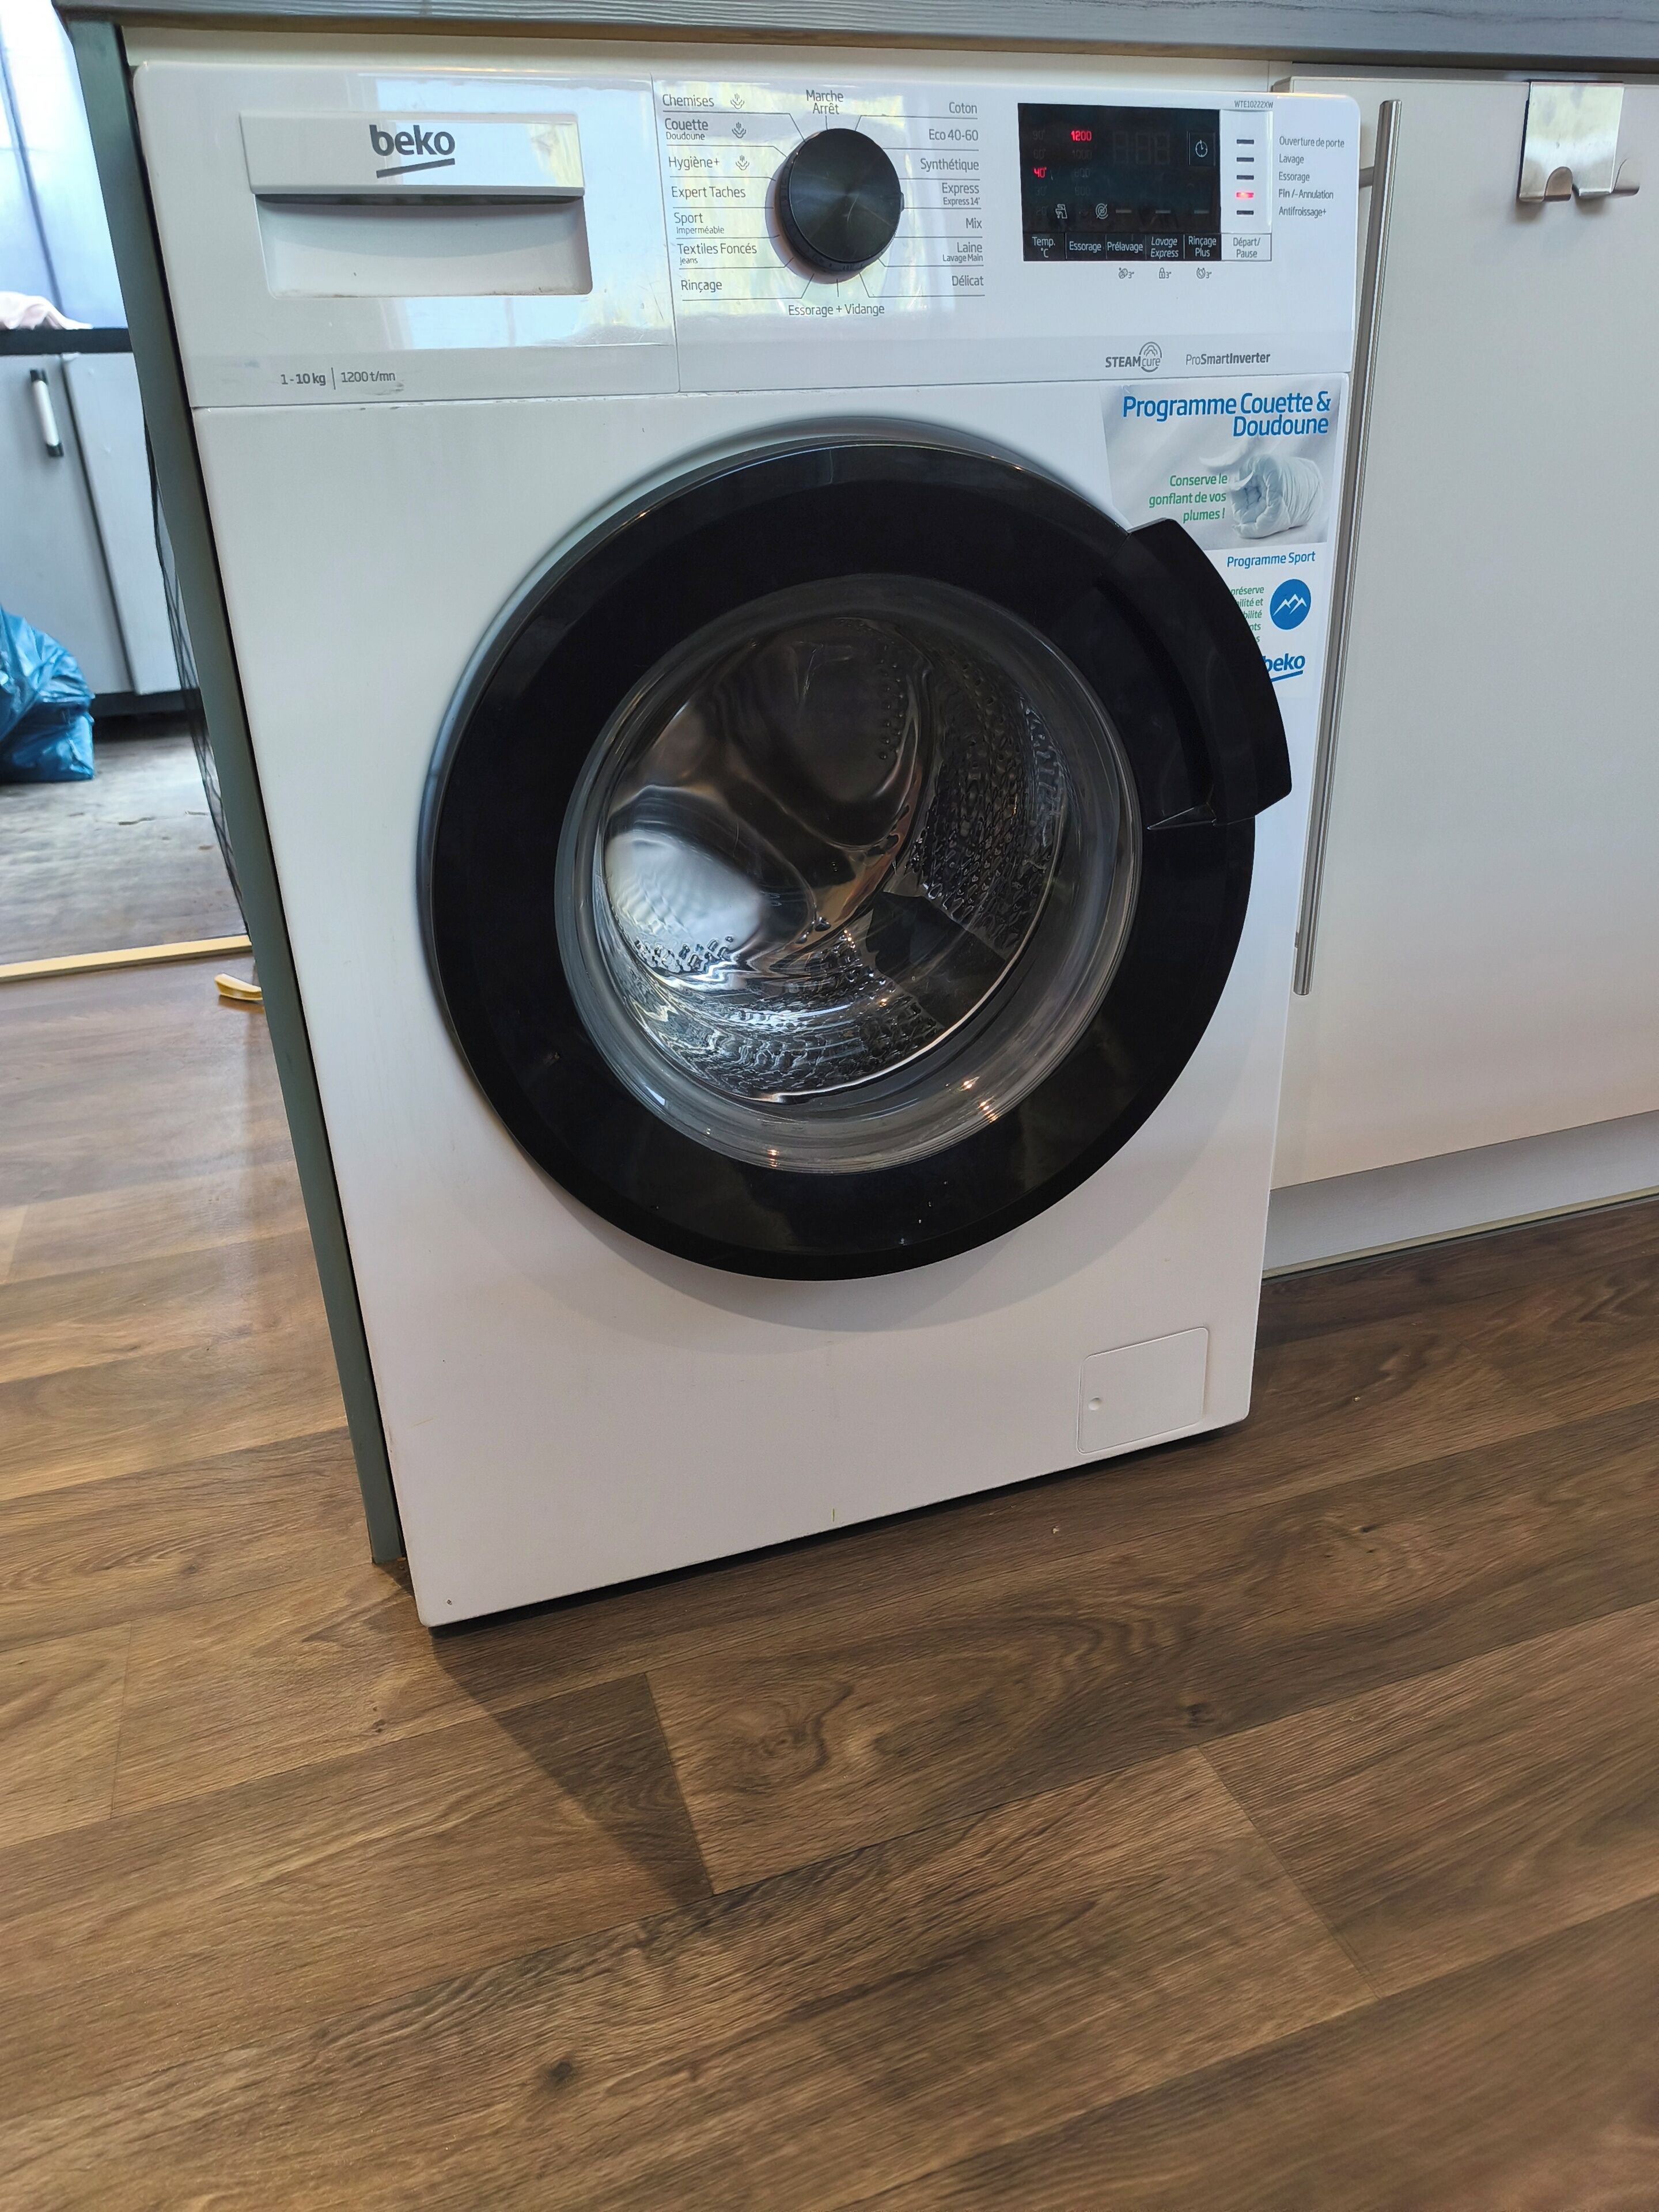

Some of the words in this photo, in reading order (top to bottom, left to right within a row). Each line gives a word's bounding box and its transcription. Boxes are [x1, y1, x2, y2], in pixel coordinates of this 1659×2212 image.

[662, 94, 715, 107] Chemises
[806, 89, 844, 103] Marche
[812, 102, 840, 115] Arrêt
[949, 101, 978, 114] Coton
[665, 118, 709, 131] Couette
[369, 124, 456, 157] beko
[666, 131, 706, 141] Doudoune
[929, 128, 946, 141] Eco
[948, 129, 979, 142] 40-60
[1070, 130, 1092, 142] 1200
[1279, 135, 1315, 146] Ouverture
[1316, 137, 1325, 147] de
[1325, 139, 1344, 149] porte
[668, 156, 720, 171] Hygiène+
[920, 158, 979, 173] Synthétique
[1279, 153, 1305, 166] Lavage
[1278, 171, 1310, 184] Essorage
[671, 186, 707, 200] Expert
[709, 186, 746, 198] Taches
[941, 182, 979, 196] Express
[1278, 188, 1290, 198] Fin
[1298, 189, 1334, 199] Annulation
[943, 197, 969, 207] Express
[970, 197, 980, 205] 14'
[674, 212, 704, 226] Sport
[1278, 206, 1327, 219] Antifroissage+
[965, 217, 982, 229] Mix
[957, 241, 983, 253] Laine
[1032, 236, 1055, 247] Temp.
[1069, 241, 1102, 252] Essorage
[1107, 241, 1143, 252] Prélavage
[1151, 237, 1177, 247] Lavage
[1188, 235, 1217, 249] Rinçage
[1233, 237, 1261, 248] Départ/
[677, 243, 718, 255] Textiles
[720, 242, 757, 255] Foncés
[1040, 248, 1049, 258] °C
[1150, 248, 1179, 259] Express
[1195, 248, 1210, 257] Plus
[1236, 249, 1257, 258] Pause
[942, 253, 967, 263] Lavage
[967, 253, 983, 262] Main
[681, 279, 722, 293] Rinçage
[952, 275, 984, 286] Délicat
[788, 305, 834, 317] Essorage
[844, 304, 885, 317] Vidange
[1185, 353, 1271, 366] ProSmartInverter
[340, 372, 368, 383] 1200
[369, 370, 396, 382] t/mn
[1123, 395, 1236, 422] Programme
[1240, 392, 1313, 414] Couette
[1317, 391, 1331, 412] &
[1233, 414, 1330, 437] Doudoune
[1169, 474, 1217, 487] Conserve
[1218, 472, 1228, 485] le
[1149, 493, 1193, 508] gonflant
[1195, 493, 1208, 504] de
[1209, 494, 1226, 503] vos
[1183, 509, 1220, 524] plumes
[1222, 507, 1225, 519] !
[1226, 555, 1286, 569] Programme
[1288, 551, 1316, 565] Sport
[1255, 598, 1263, 607] et
[1262, 653, 1305, 672] beko
